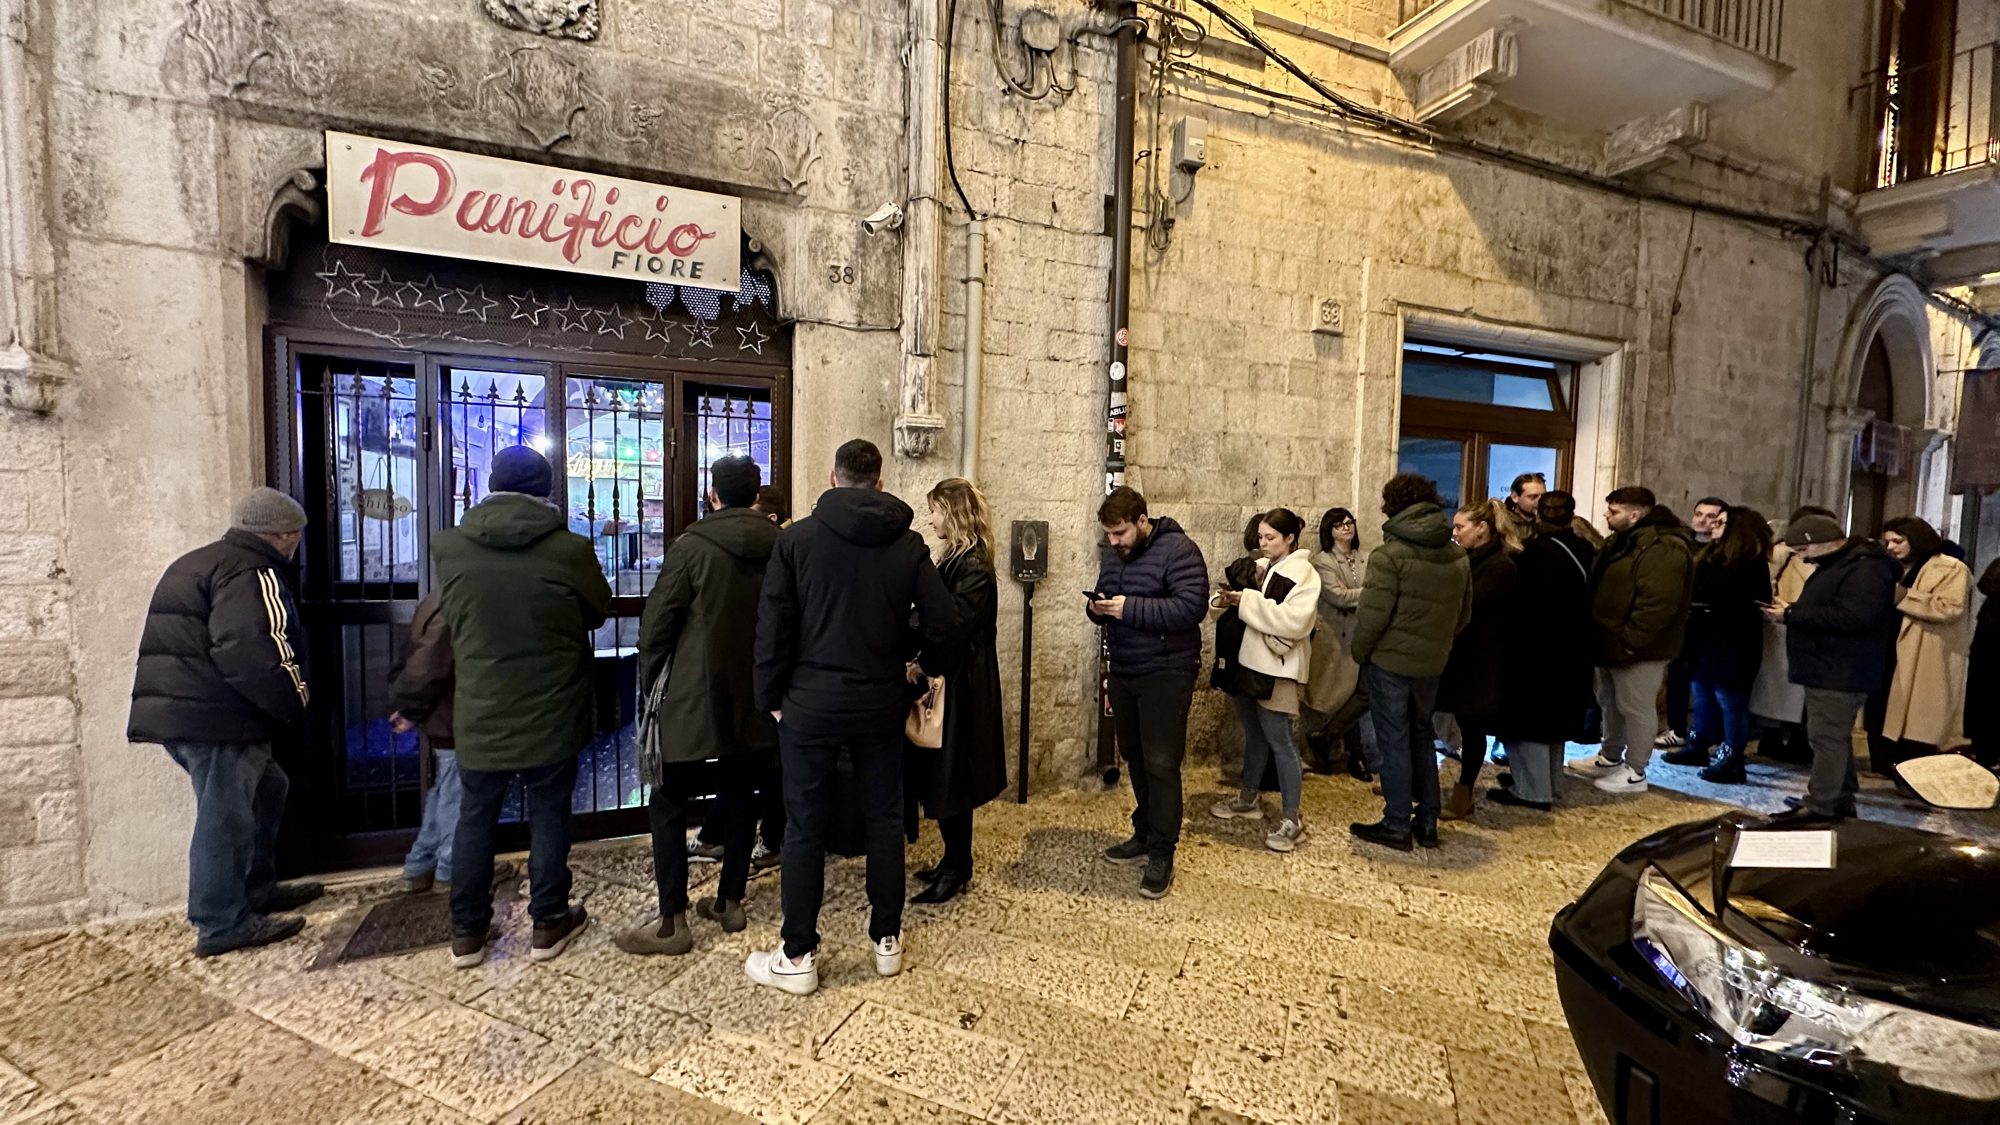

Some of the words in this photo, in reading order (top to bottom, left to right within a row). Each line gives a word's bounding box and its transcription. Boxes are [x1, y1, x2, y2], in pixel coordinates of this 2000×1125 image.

[360, 147, 717, 265] Panificio
[611, 250, 705, 280] FIORE
[829, 264, 855, 285] 38
[1322, 306, 1339, 325] 39
